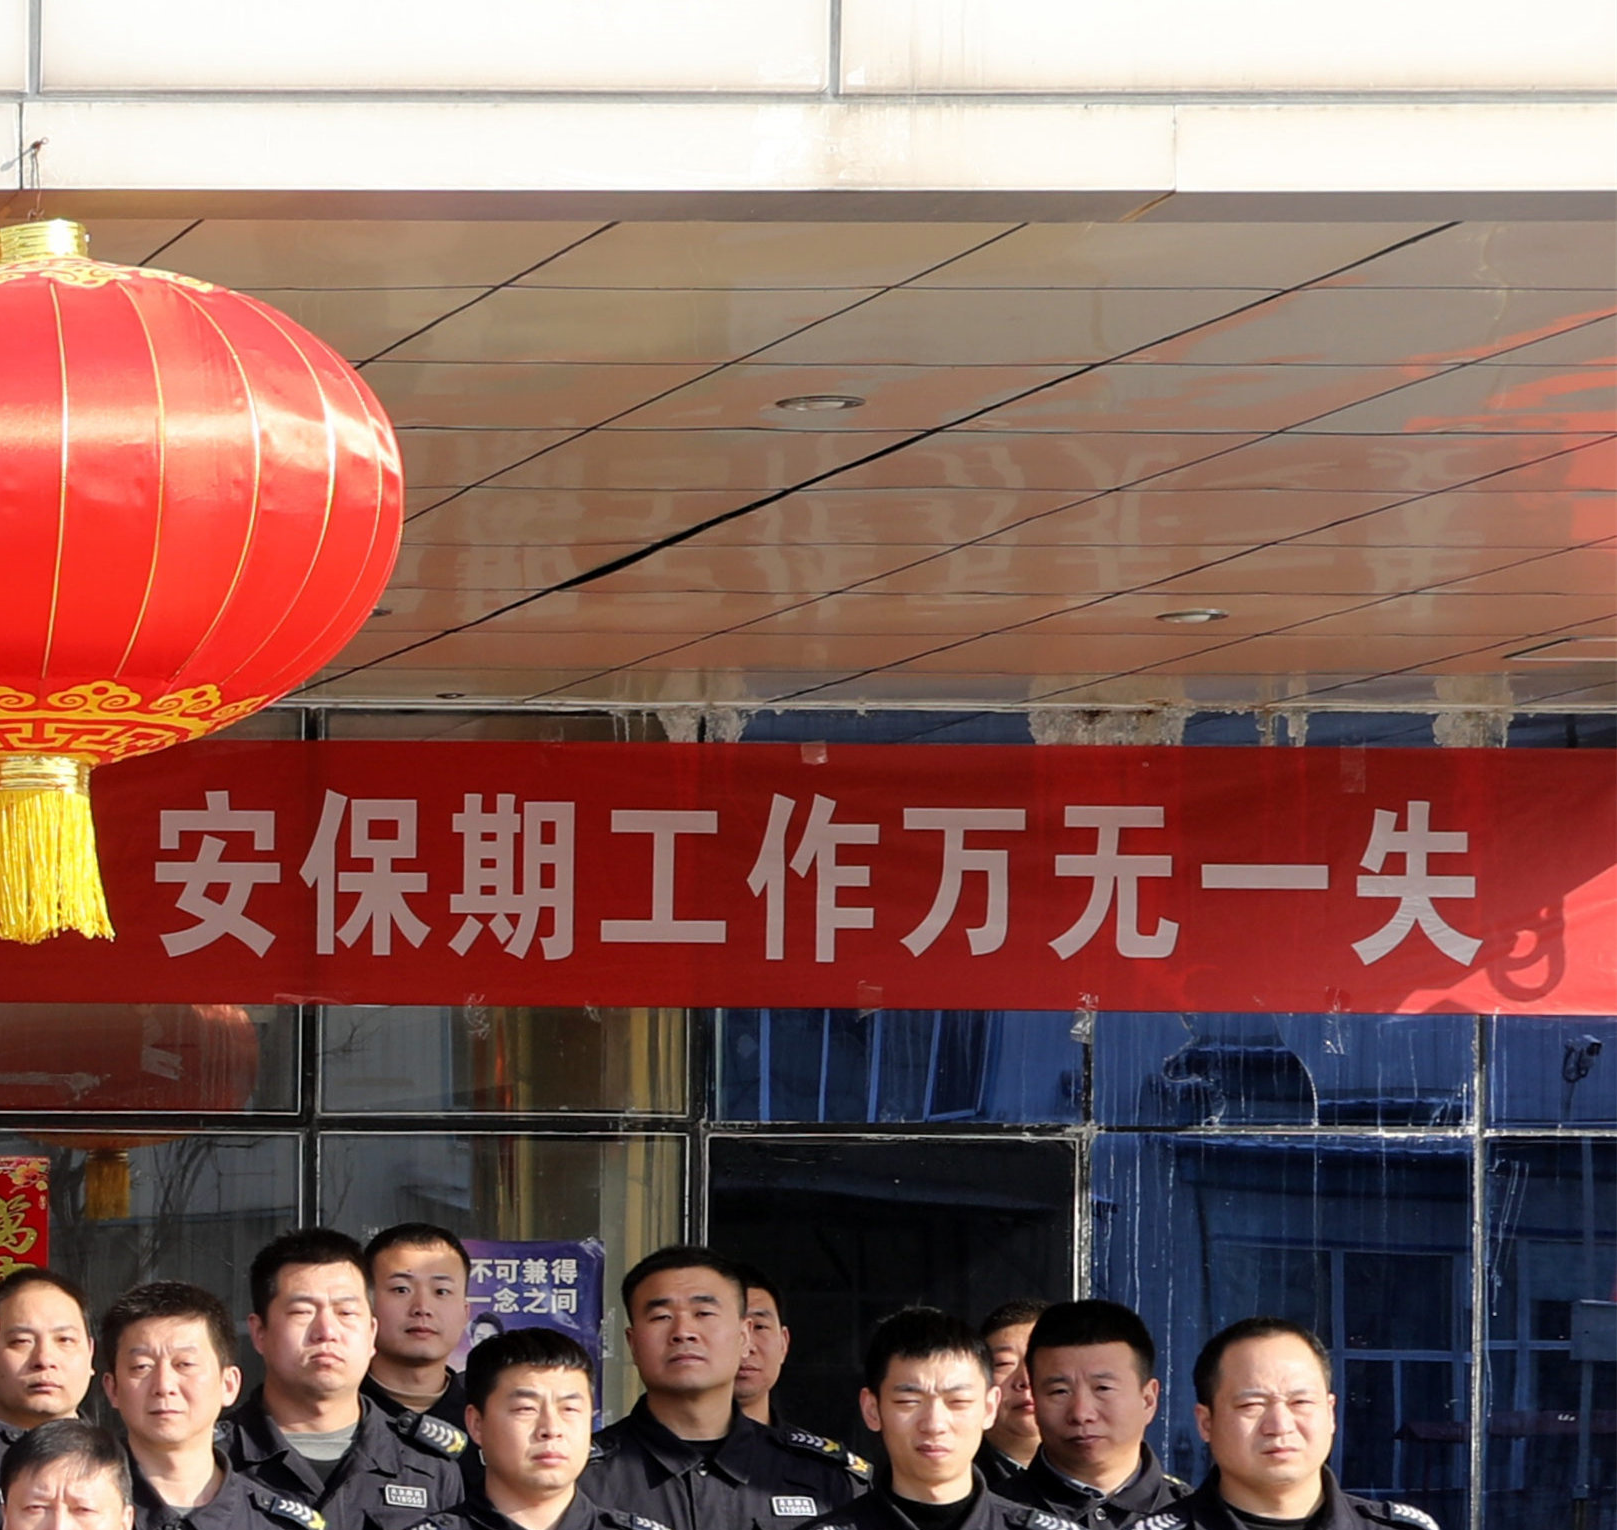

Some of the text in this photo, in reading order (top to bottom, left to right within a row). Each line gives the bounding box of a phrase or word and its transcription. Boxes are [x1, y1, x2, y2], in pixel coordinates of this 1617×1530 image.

[153, 789, 1483, 967] 安保期工作万无一失
[469, 1258, 578, 1284] 不可兼得
[465, 1288, 577, 1314] 一念之间
